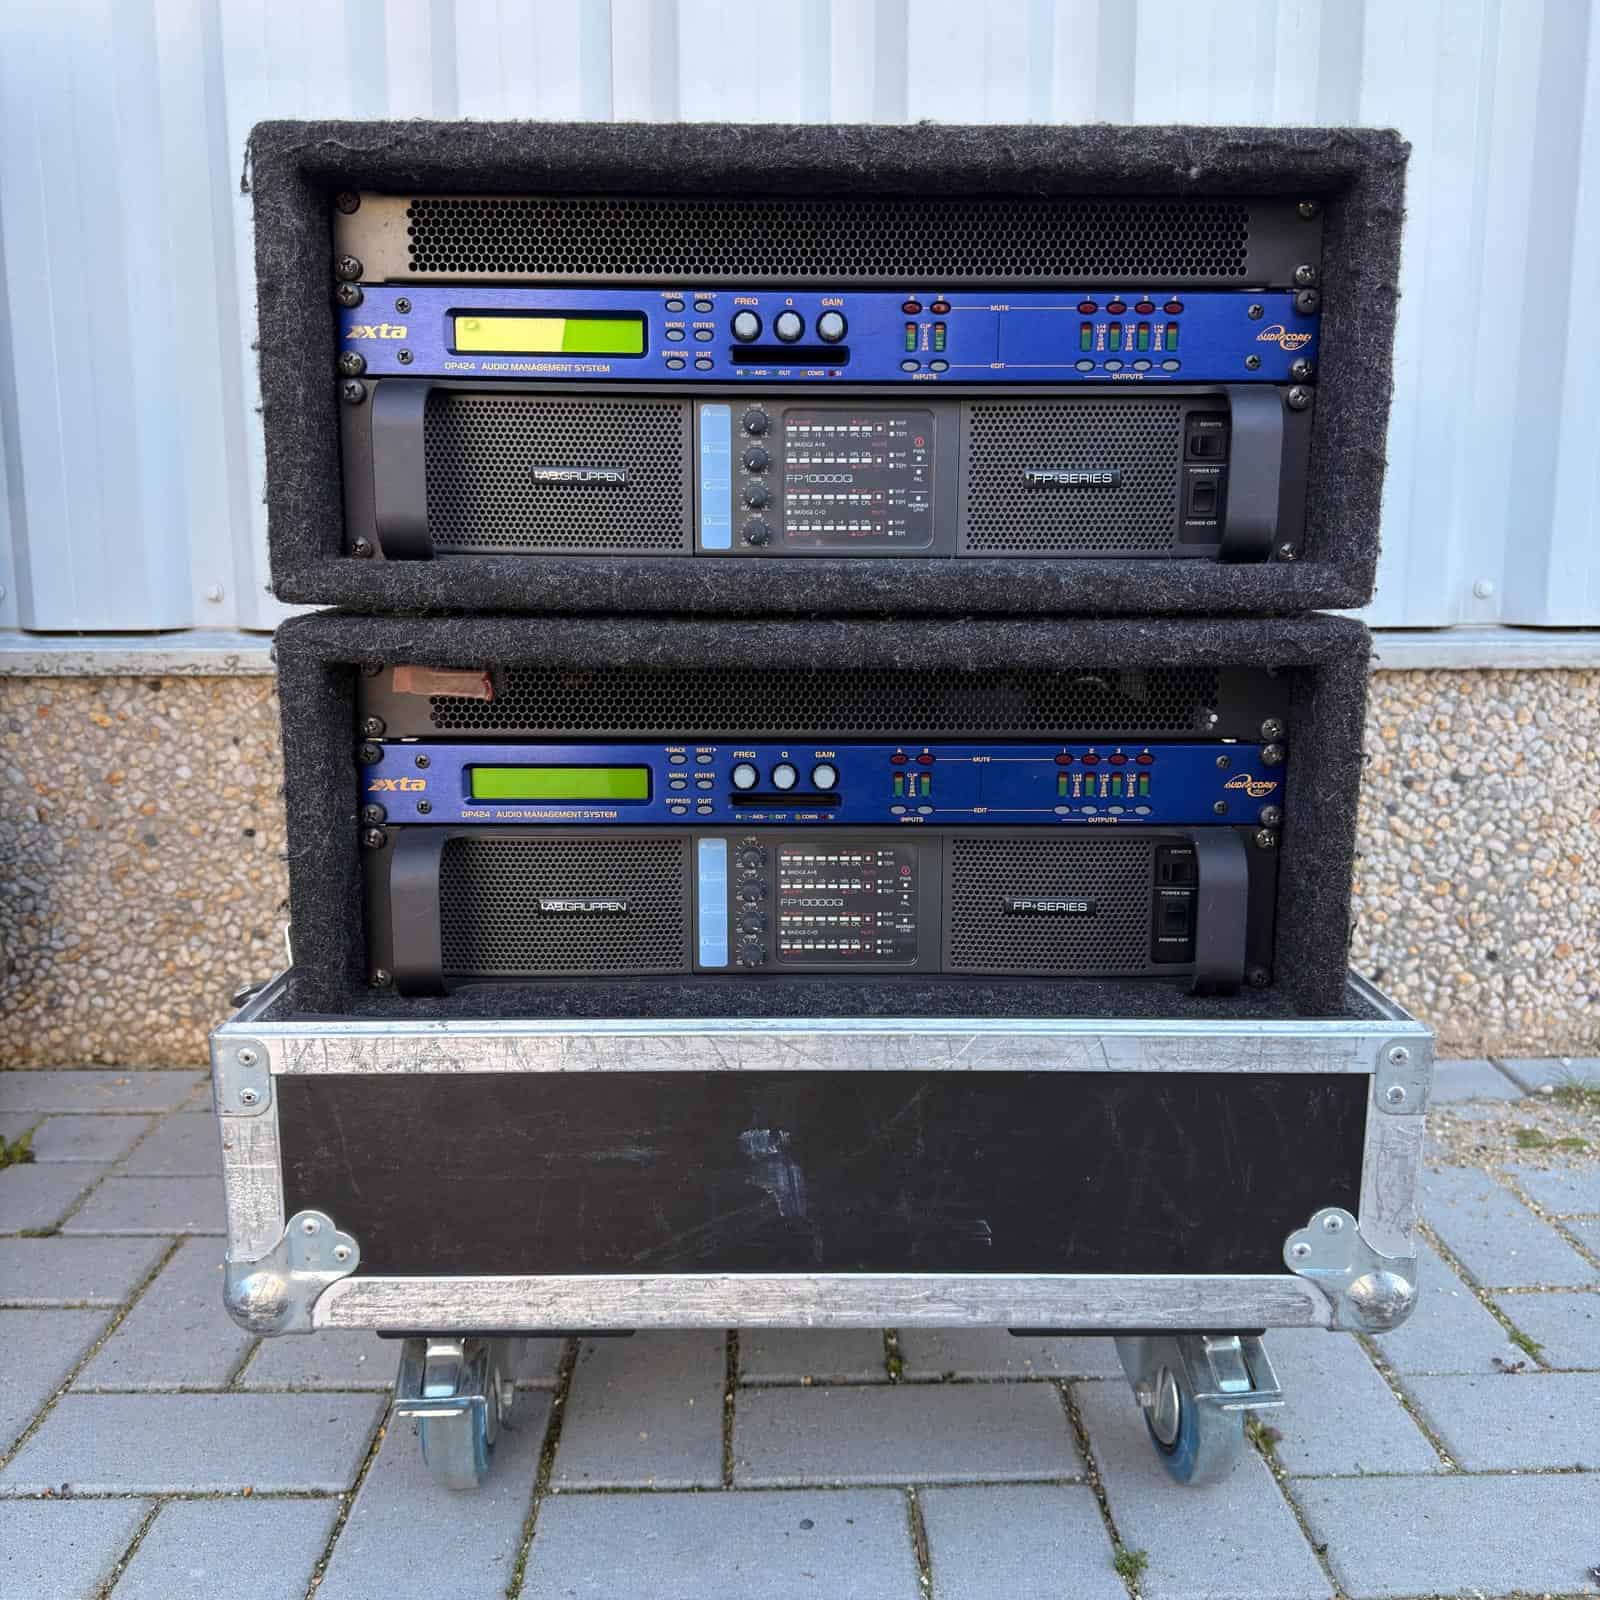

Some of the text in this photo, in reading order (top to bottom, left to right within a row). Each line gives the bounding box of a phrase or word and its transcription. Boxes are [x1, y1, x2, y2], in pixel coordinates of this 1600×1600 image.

[734, 297, 759, 306] FREQ
[785, 298, 793, 306] Q
[822, 298, 844, 306] GAIN
[990, 304, 1010, 312] MUTE
[692, 321, 715, 329] ENTER
[481, 362, 509, 371] AUDIO
[510, 363, 573, 373] MANAGEMENT
[574, 364, 611, 373] SYSTEM
[733, 751, 756, 759] FREQ
[781, 751, 789, 759] Q
[815, 751, 836, 759] GAIN
[496, 810, 523, 819] AUDIO
[524, 810, 582, 819] MANAGEMENT
[583, 810, 618, 819] SYSTEM
